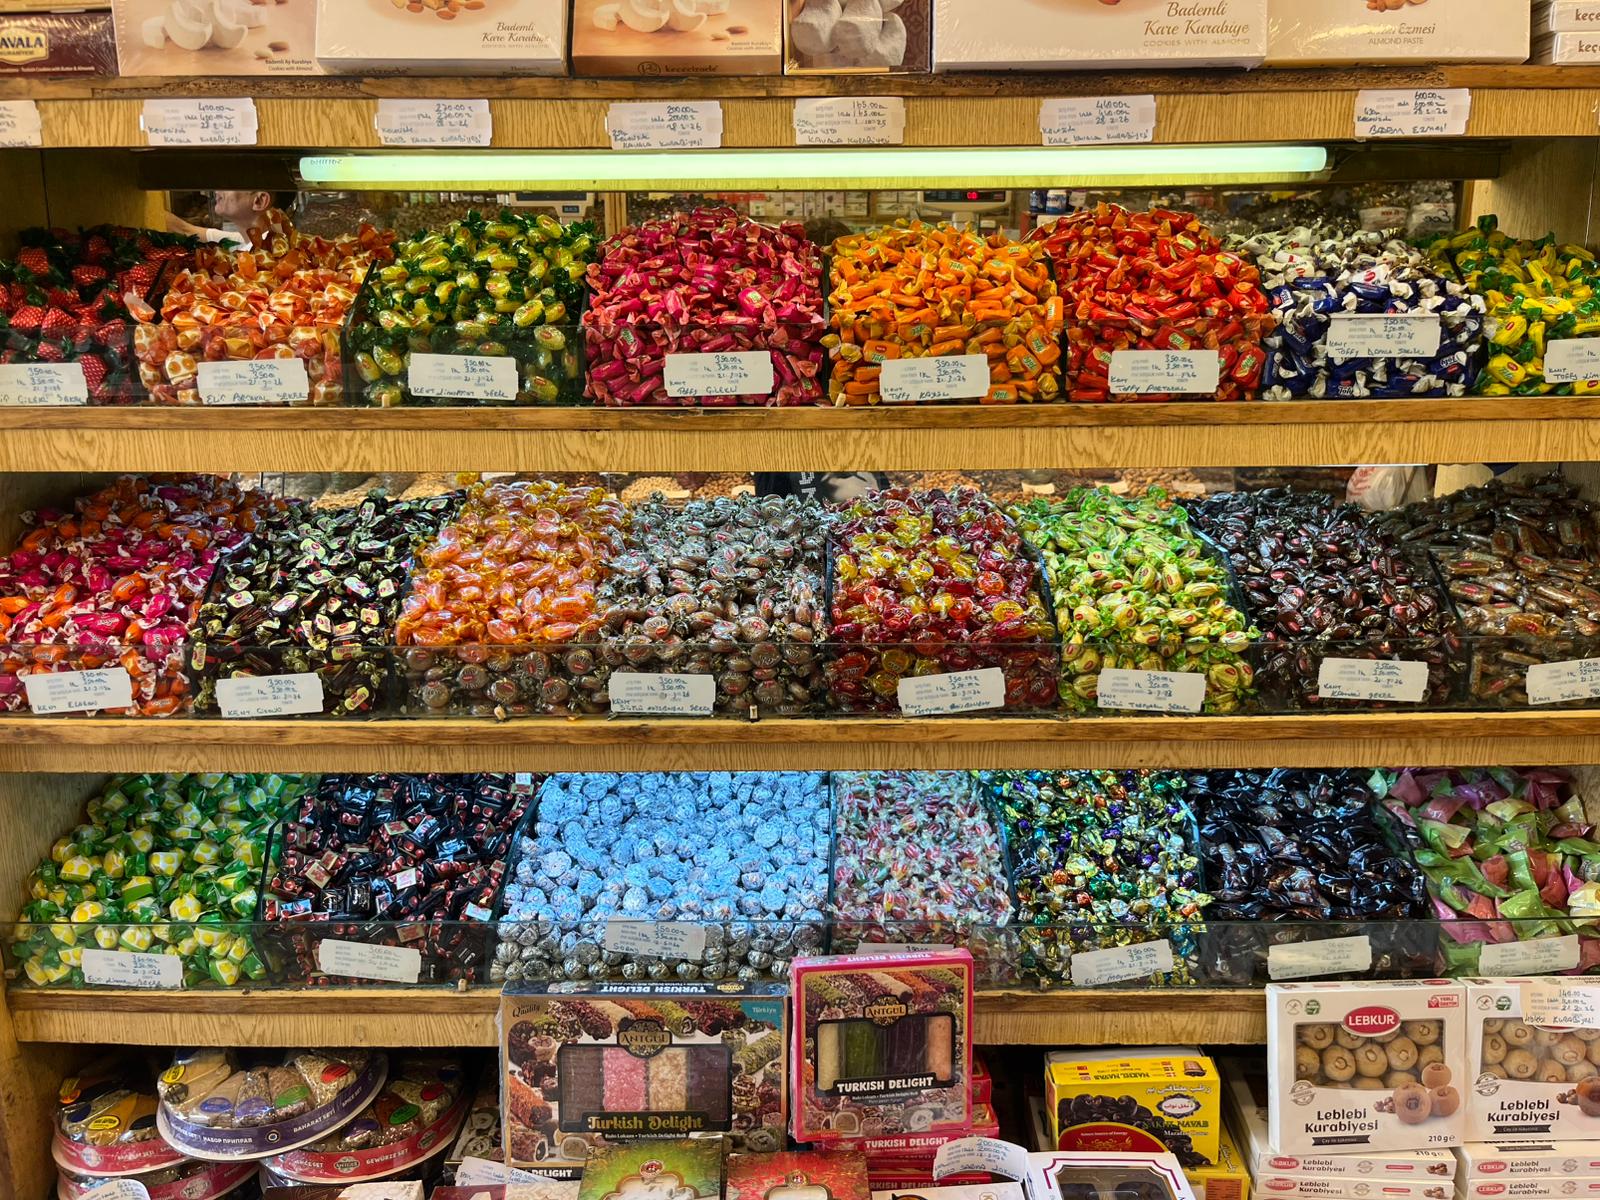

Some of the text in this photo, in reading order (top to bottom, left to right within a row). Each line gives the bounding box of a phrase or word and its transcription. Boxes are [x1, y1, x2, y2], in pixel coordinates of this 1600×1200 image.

[1167, 0, 1228, 17] Bademli
[497, 22, 535, 32] Bademli
[1144, 19, 1250, 37] Kare Kurabiye
[1398, 22, 1436, 35] Ezmesi
[482, 33, 505, 43] Kare
[1143, 38, 1250, 48] COOKIES WITH ALMOND
[1368, 37, 1424, 45] ALMOND PASTE
[1578, 40, 1600, 55] keç
[600, 985, 706, 994] TURKISH DELIGHT
[1348, 1014, 1396, 1026] LEBKUR
[837, 1076, 934, 1094] TURKISH DELIGHT
[1500, 1099, 1549, 1111] Leblebi
[1317, 1108, 1367, 1121] Leblebi
[1487, 1110, 1560, 1124] Kurabiyesi
[587, 1115, 704, 1131] Turkish Delight
[1305, 1120, 1378, 1134] Kurabiyesi
[864, 1137, 949, 1149] TURKISH DELIGHT
[1428, 1135, 1443, 1143] 210
[1303, 1158, 1333, 1167] Leblebi
[1510, 1160, 1539, 1168] Leblebi
[1302, 1164, 1346, 1173] Kurabiyesi
[1509, 1165, 1551, 1174] Kurabiyesi
[532, 1169, 573, 1179] DELIGHT
[1299, 1180, 1330, 1189] Leblebi
[1509, 1182, 1538, 1190] Leblebi
[1299, 1186, 1342, 1196] Kurabiyesi
[1508, 1187, 1551, 1196] Kurabiyesi
